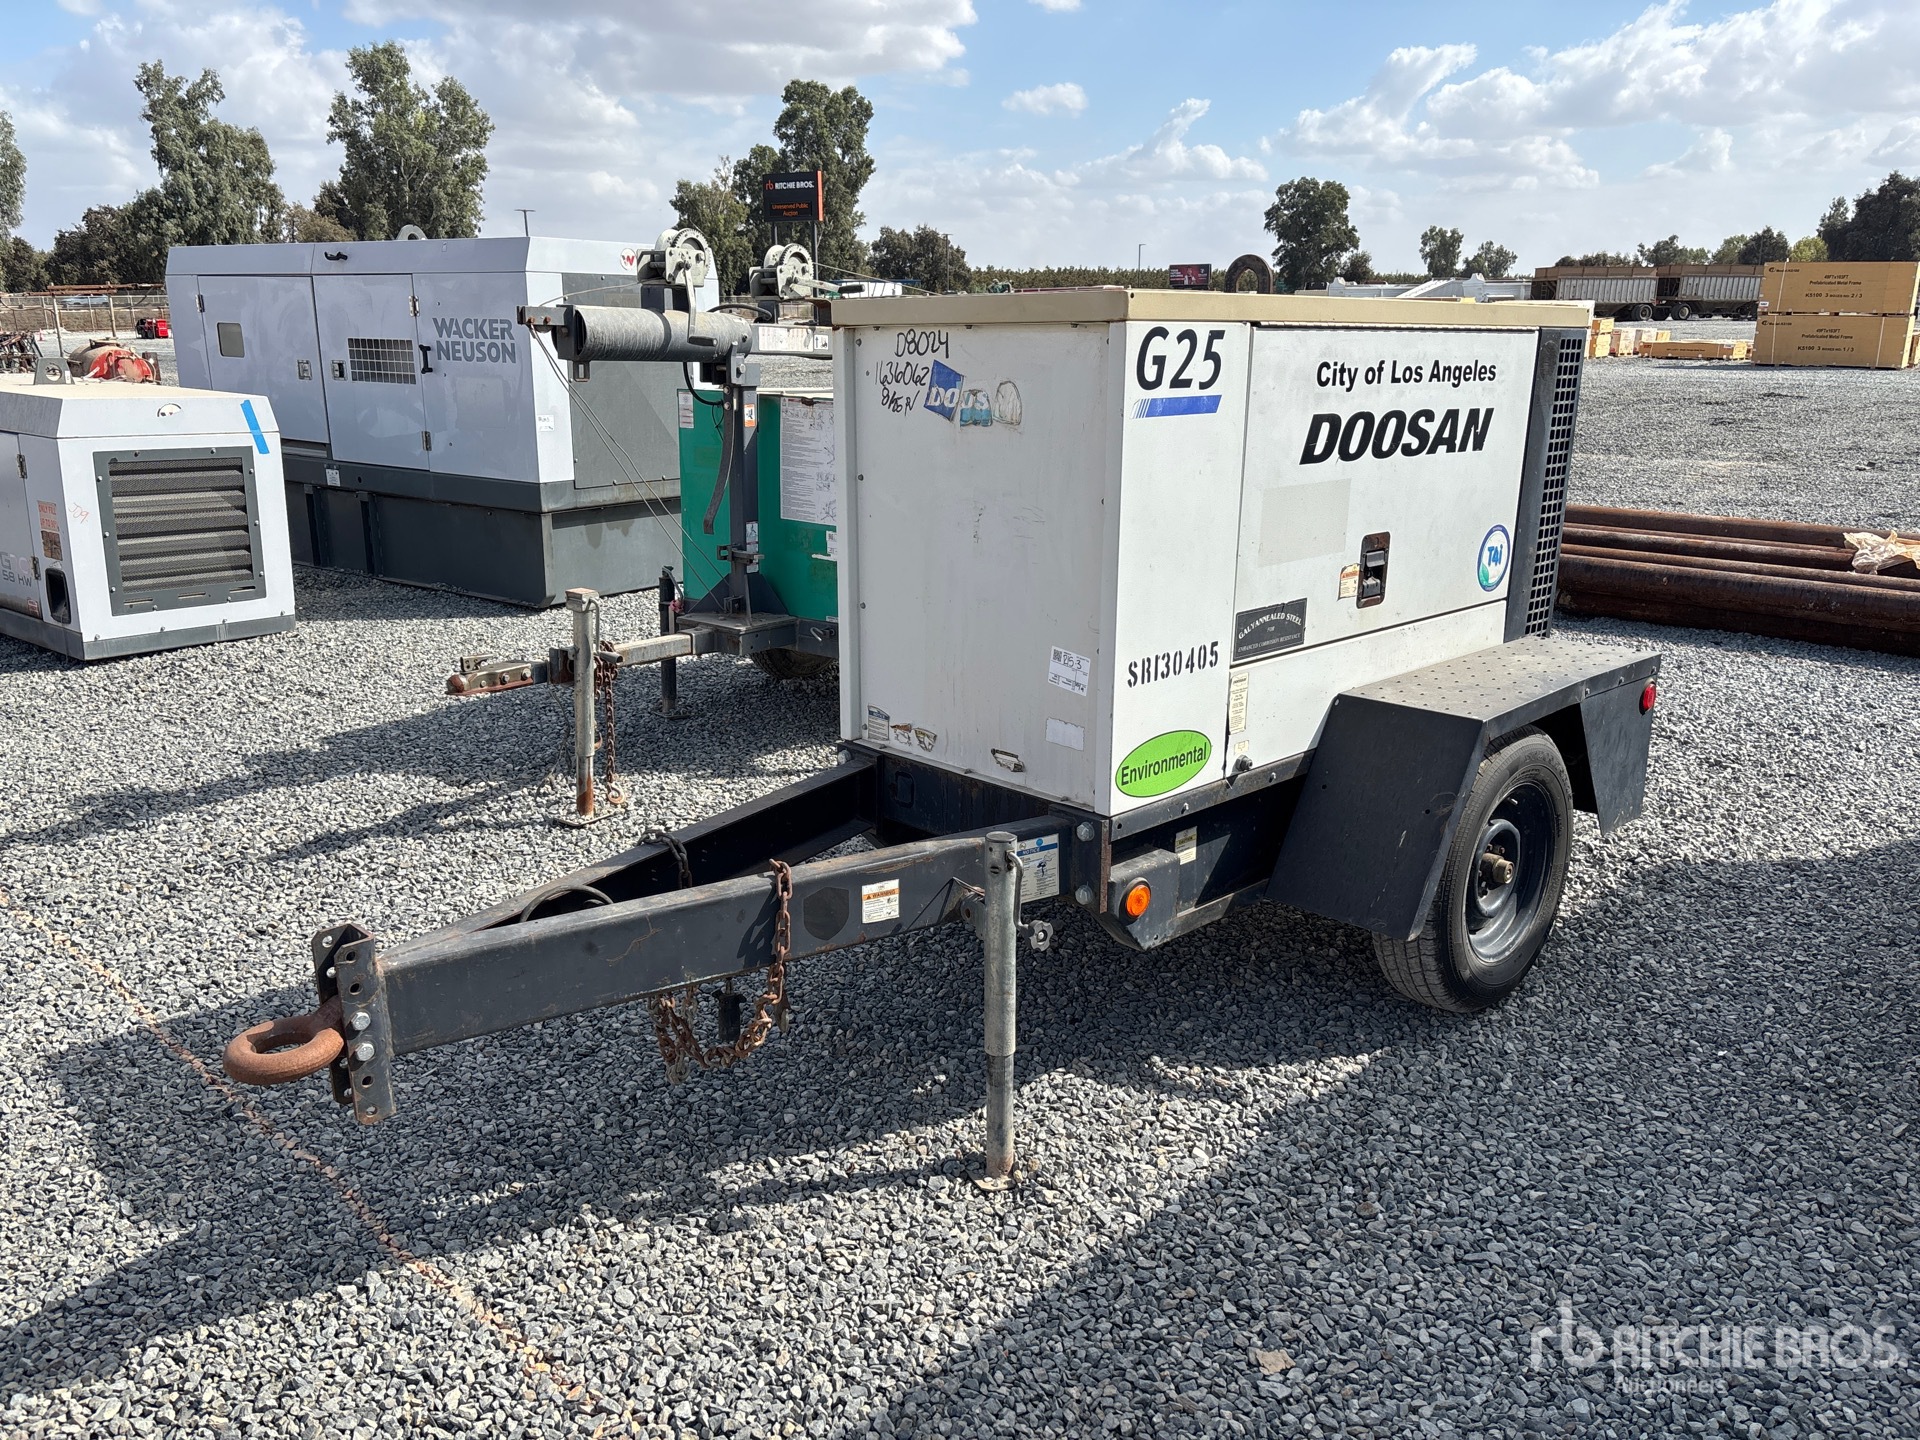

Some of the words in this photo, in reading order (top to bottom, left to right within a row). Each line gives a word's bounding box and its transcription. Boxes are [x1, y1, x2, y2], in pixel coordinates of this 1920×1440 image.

[432, 317, 515, 340] WACKER
[436, 340, 516, 363] NEUSON
[894, 328, 949, 359] D8024
[1136, 326, 1226, 391] G25
[1316, 361, 1358, 392] City
[1364, 360, 1385, 384] of
[1391, 360, 1423, 384] Los
[1428, 359, 1496, 388] Angeles
[1299, 407, 1495, 465] DOOSAN
[18, 574, 32, 587] HW
[1286, 613, 1302, 625] STEEL
[1121, 742, 1207, 786] Environmental
[1022, 846, 1040, 855] NOTICE
[872, 889, 897, 898] WARNING
